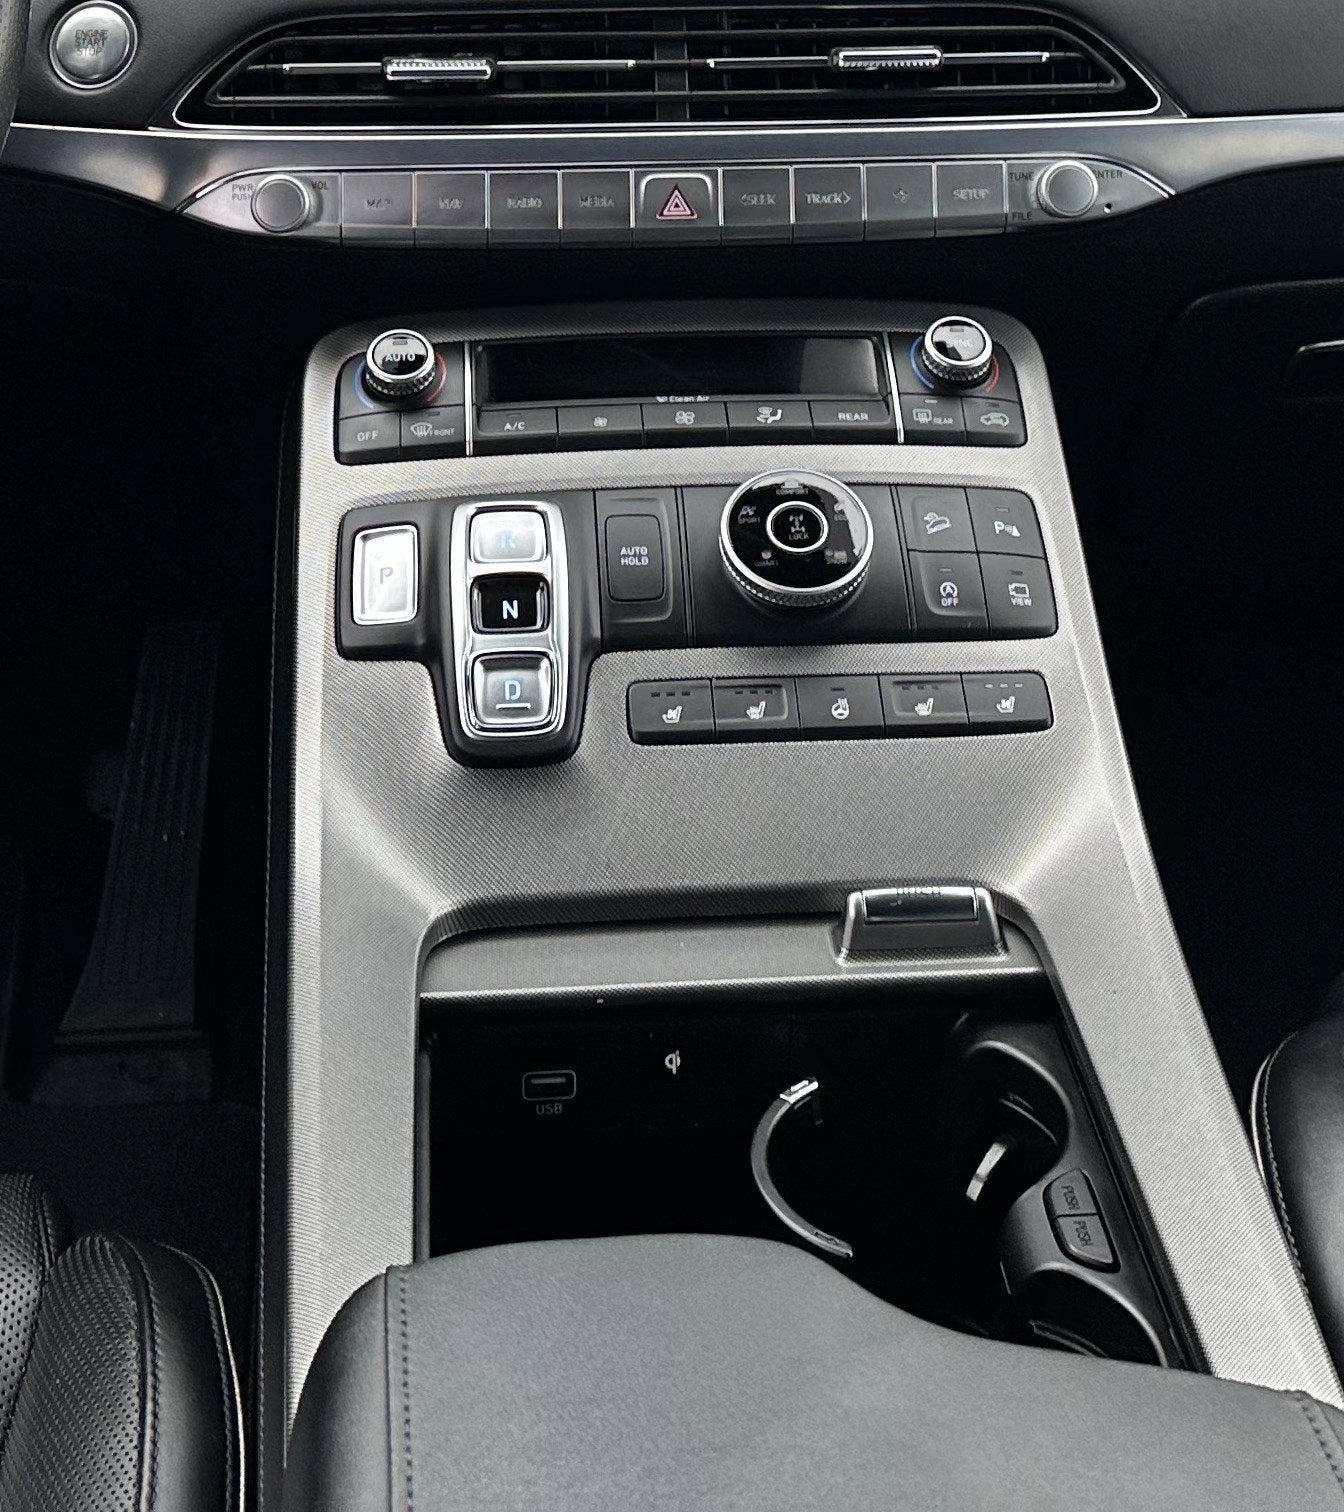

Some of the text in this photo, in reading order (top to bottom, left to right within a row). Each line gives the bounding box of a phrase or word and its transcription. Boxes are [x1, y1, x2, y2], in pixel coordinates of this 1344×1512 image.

[1008, 171, 1035, 182] TUNE
[1095, 169, 1124, 180] NTER
[384, 353, 416, 363] AUTO
[837, 412, 869, 422] REAR
[933, 416, 954, 426] REAR
[429, 426, 455, 438] FRONT
[504, 421, 526, 432] A/C
[356, 430, 379, 442] OFF
[619, 545, 648, 556] AUTO
[620, 555, 649, 567] HOLD
[379, 566, 394, 585] P
[940, 597, 959, 607] OFF
[1009, 597, 1033, 607] VIEW
[502, 599, 520, 620] N
[504, 679, 522, 701] D
[535, 1102, 563, 1116] USB
[1060, 1184, 1081, 1210] PUSH
[1072, 1220, 1094, 1248] PUSH
